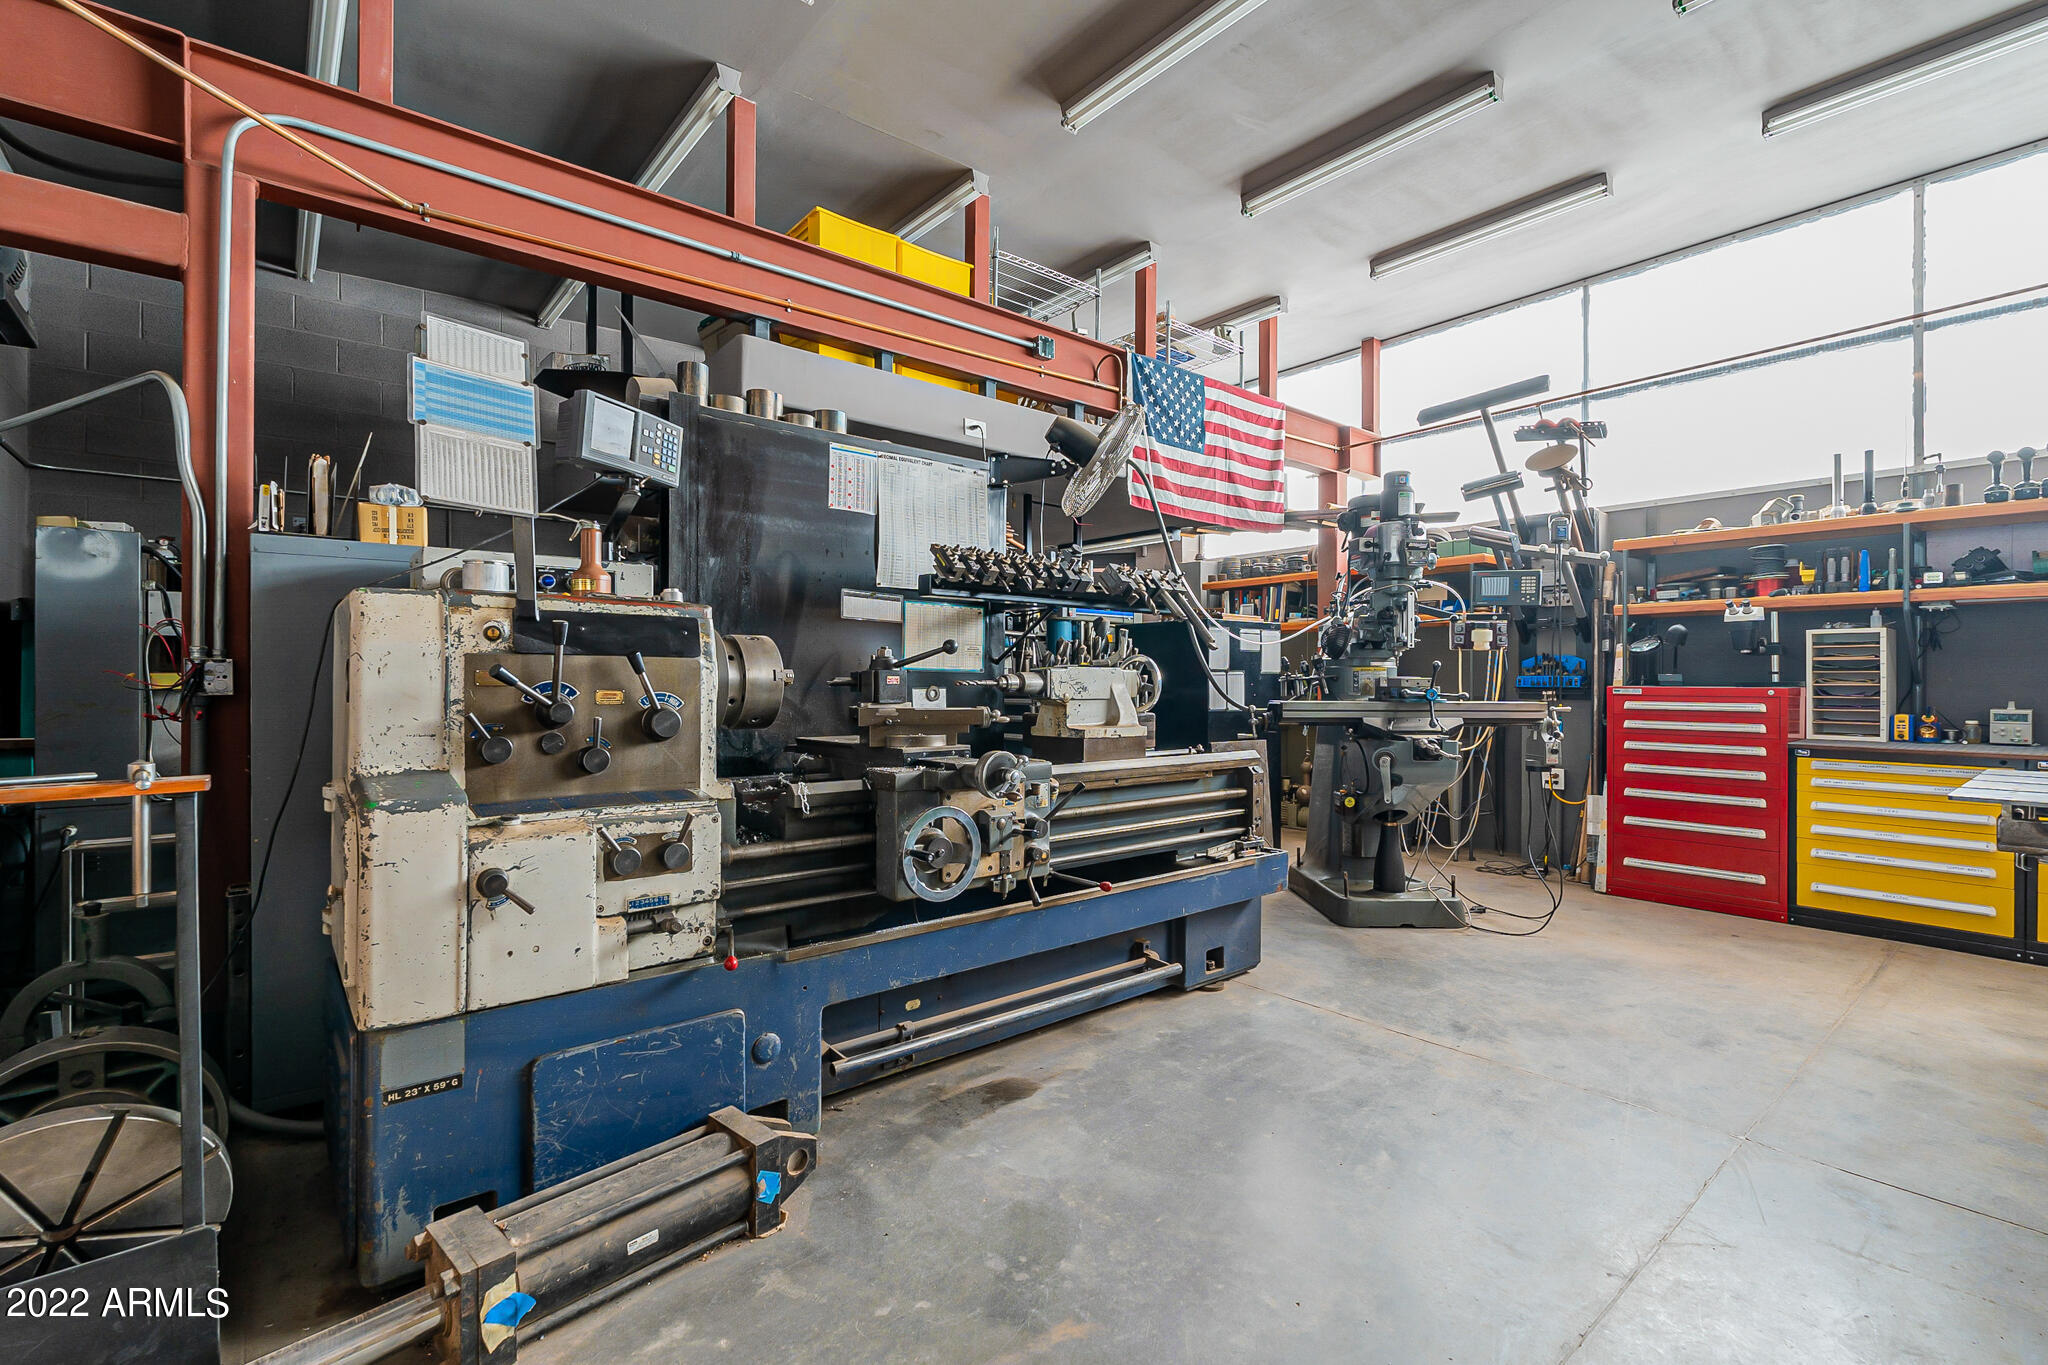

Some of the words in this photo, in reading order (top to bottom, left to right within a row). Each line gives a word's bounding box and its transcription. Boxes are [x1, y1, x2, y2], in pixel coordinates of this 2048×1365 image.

[387, 1092, 402, 1102] HL
[424, 1084, 431, 1093] X
[451, 1078, 459, 1086] G
